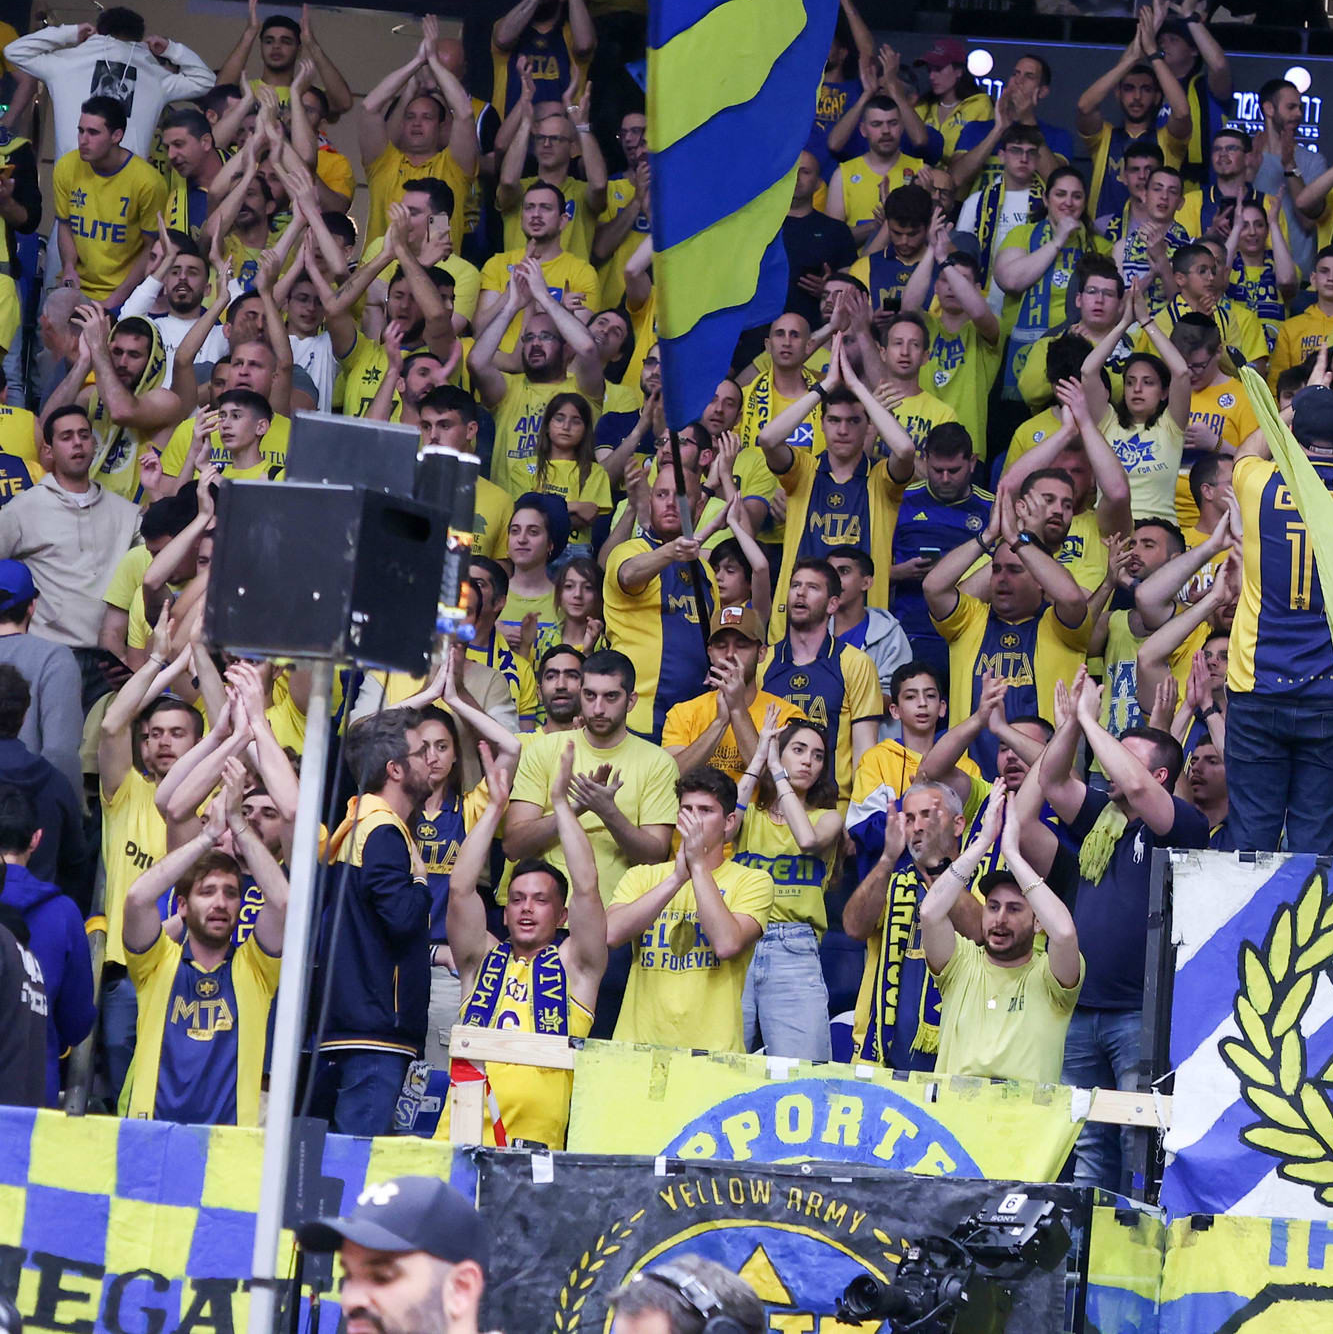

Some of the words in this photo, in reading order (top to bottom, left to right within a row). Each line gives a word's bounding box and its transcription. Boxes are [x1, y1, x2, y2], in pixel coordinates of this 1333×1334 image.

[120, 196, 131, 216] 7
[69, 213, 129, 244] ELITE
[809, 511, 860, 538] MTA
[975, 652, 1032, 680] MTA
[640, 953, 655, 969] IS
[659, 952, 722, 971] FOREVER
[169, 994, 233, 1033] MTA
[659, 1177, 772, 1212] YELLOW
[786, 1185, 868, 1235] ARMY
[1005, 1197, 1016, 1210] 6
[990, 1214, 1016, 1223] SONY
